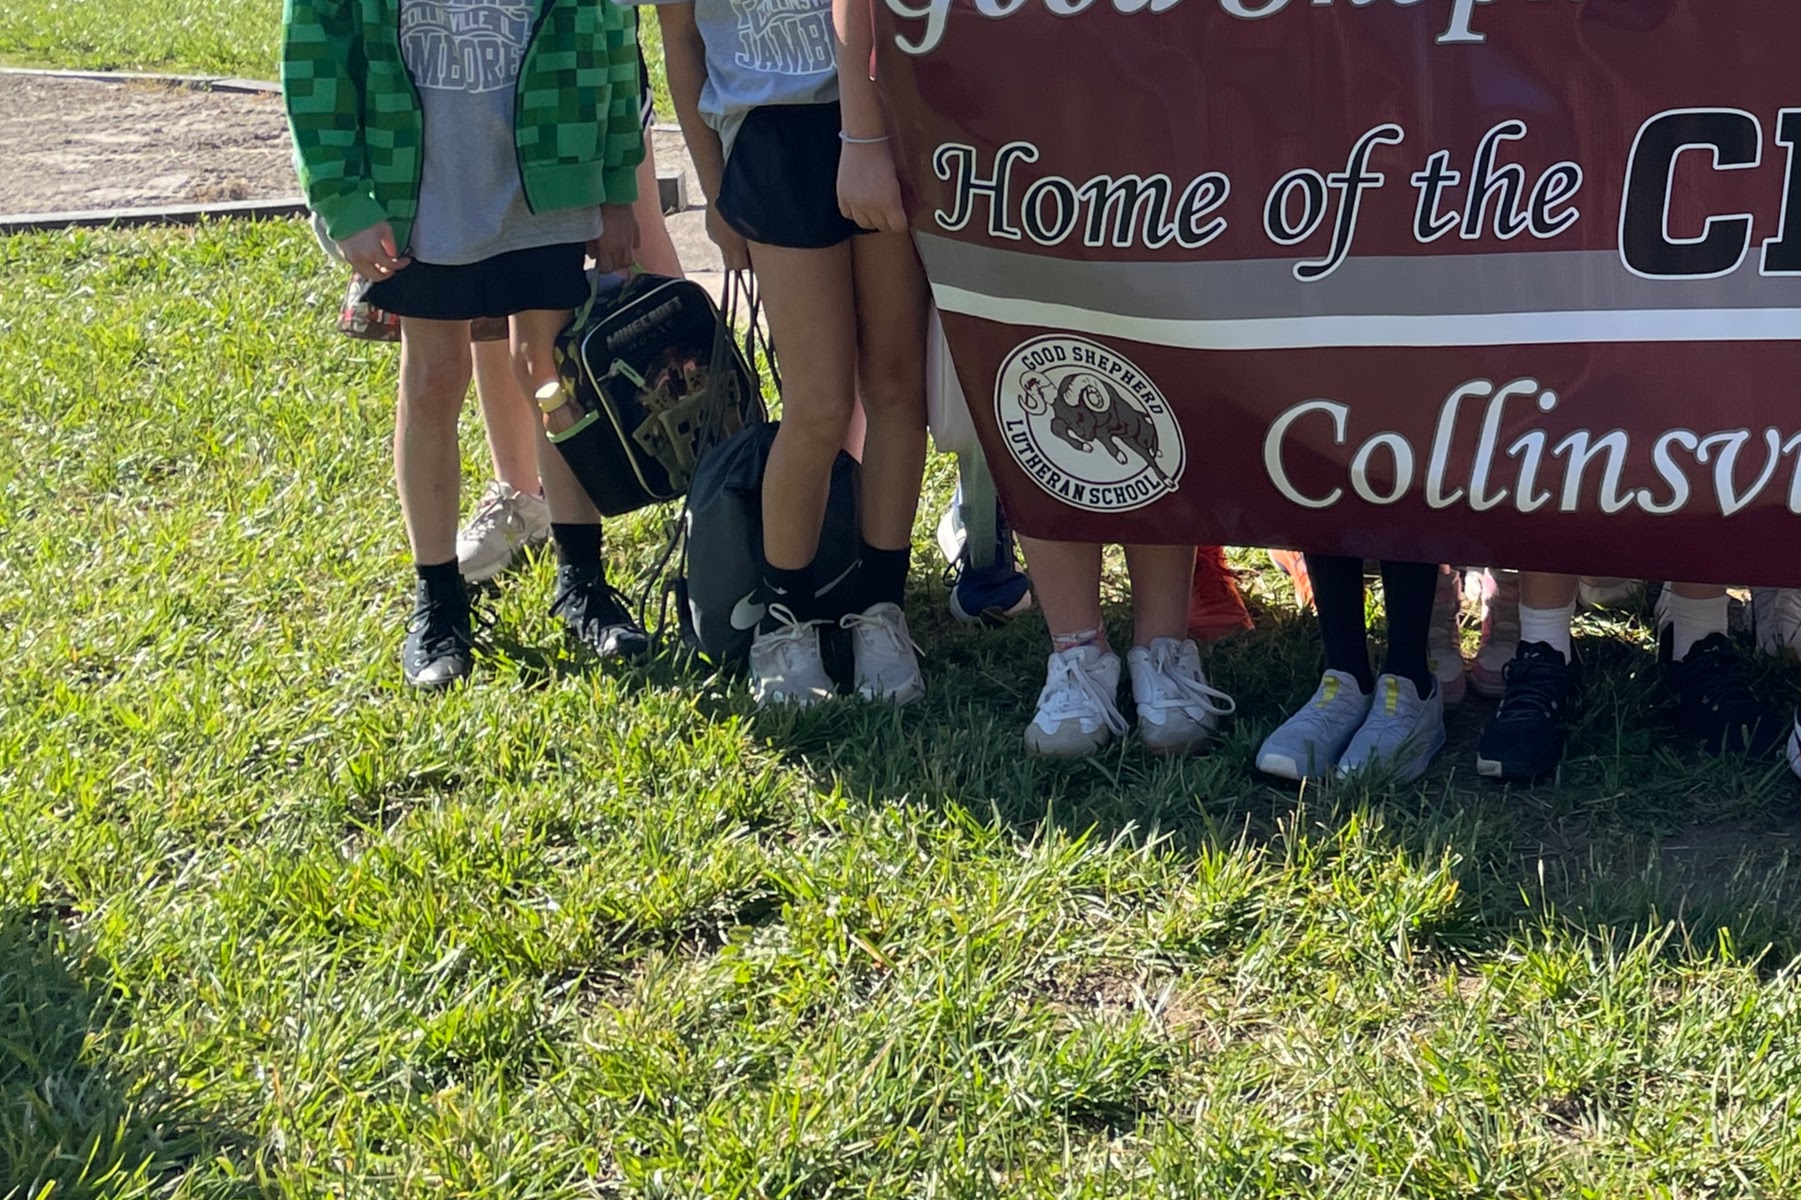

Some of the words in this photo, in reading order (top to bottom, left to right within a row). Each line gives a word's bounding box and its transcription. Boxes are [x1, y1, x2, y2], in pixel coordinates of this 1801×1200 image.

[932, 140, 1230, 250] Home
[1262, 122, 1404, 282] of
[1410, 118, 1583, 244] the
[1021, 345, 1067, 371] GOOD
[1072, 346, 1164, 415] SHEPHERD
[1006, 419, 1086, 502] LUTHERAN
[1089, 475, 1161, 506] SCHOOL
